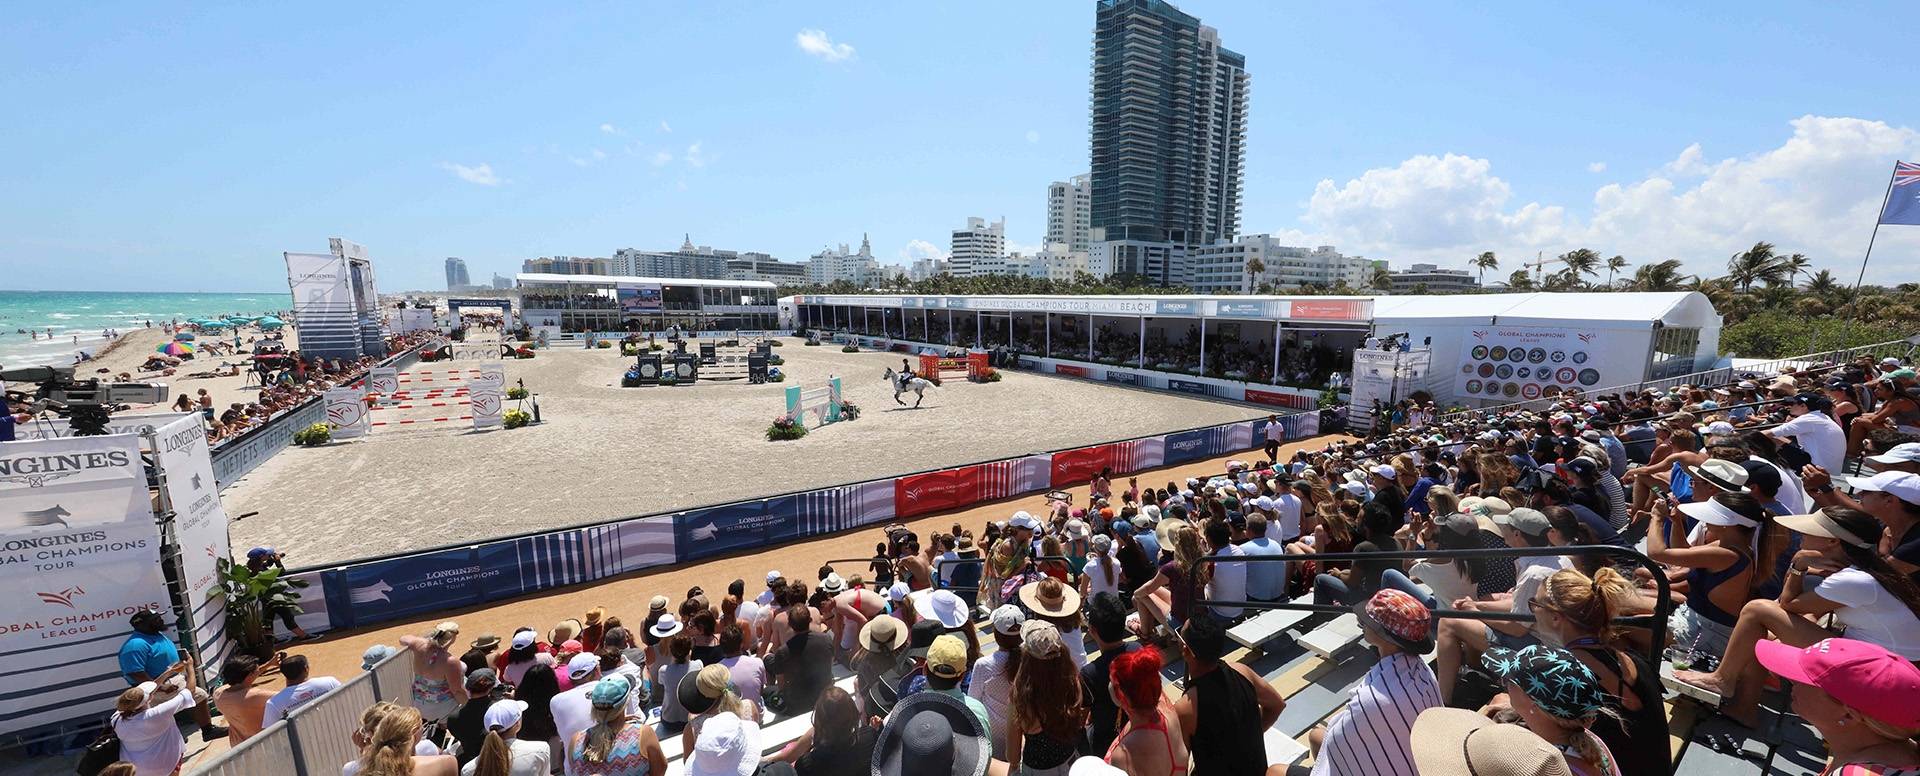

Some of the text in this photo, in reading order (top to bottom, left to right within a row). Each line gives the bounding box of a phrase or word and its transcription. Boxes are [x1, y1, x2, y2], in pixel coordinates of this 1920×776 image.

[972, 300, 1000, 308] LONGINES
[1001, 301, 1024, 309] GLOBAL
[1026, 301, 1067, 310] CHAMPIONS
[1069, 302, 1090, 310] TOUR
[1092, 302, 1117, 311] MIAMI
[1120, 302, 1151, 312] BEACH
[1360, 353, 1394, 361] LONGINES
[1108, 371, 1135, 380] LONGINES
[164, 424, 203, 453] LONGINES
[265, 423, 291, 451] NETJETS
[1172, 438, 1203, 450] LONGINES
[222, 443, 258, 479] NETJETS
[188, 493, 212, 515] LONGINES
[182, 517, 201, 531] GLOBAL
[726, 517, 786, 532] GLOBAL CHAMPIONS
[738, 514, 774, 525] LONGINES
[36, 539, 146, 560] CHAMPIONS
[34, 560, 74, 572] TOUR
[425, 565, 480, 580] LONGINES
[406, 569, 500, 591] GLOBAL CHAMPIONS
[51, 601, 160, 627] CHAMPIONS
[41, 624, 97, 639] LEAGUE
